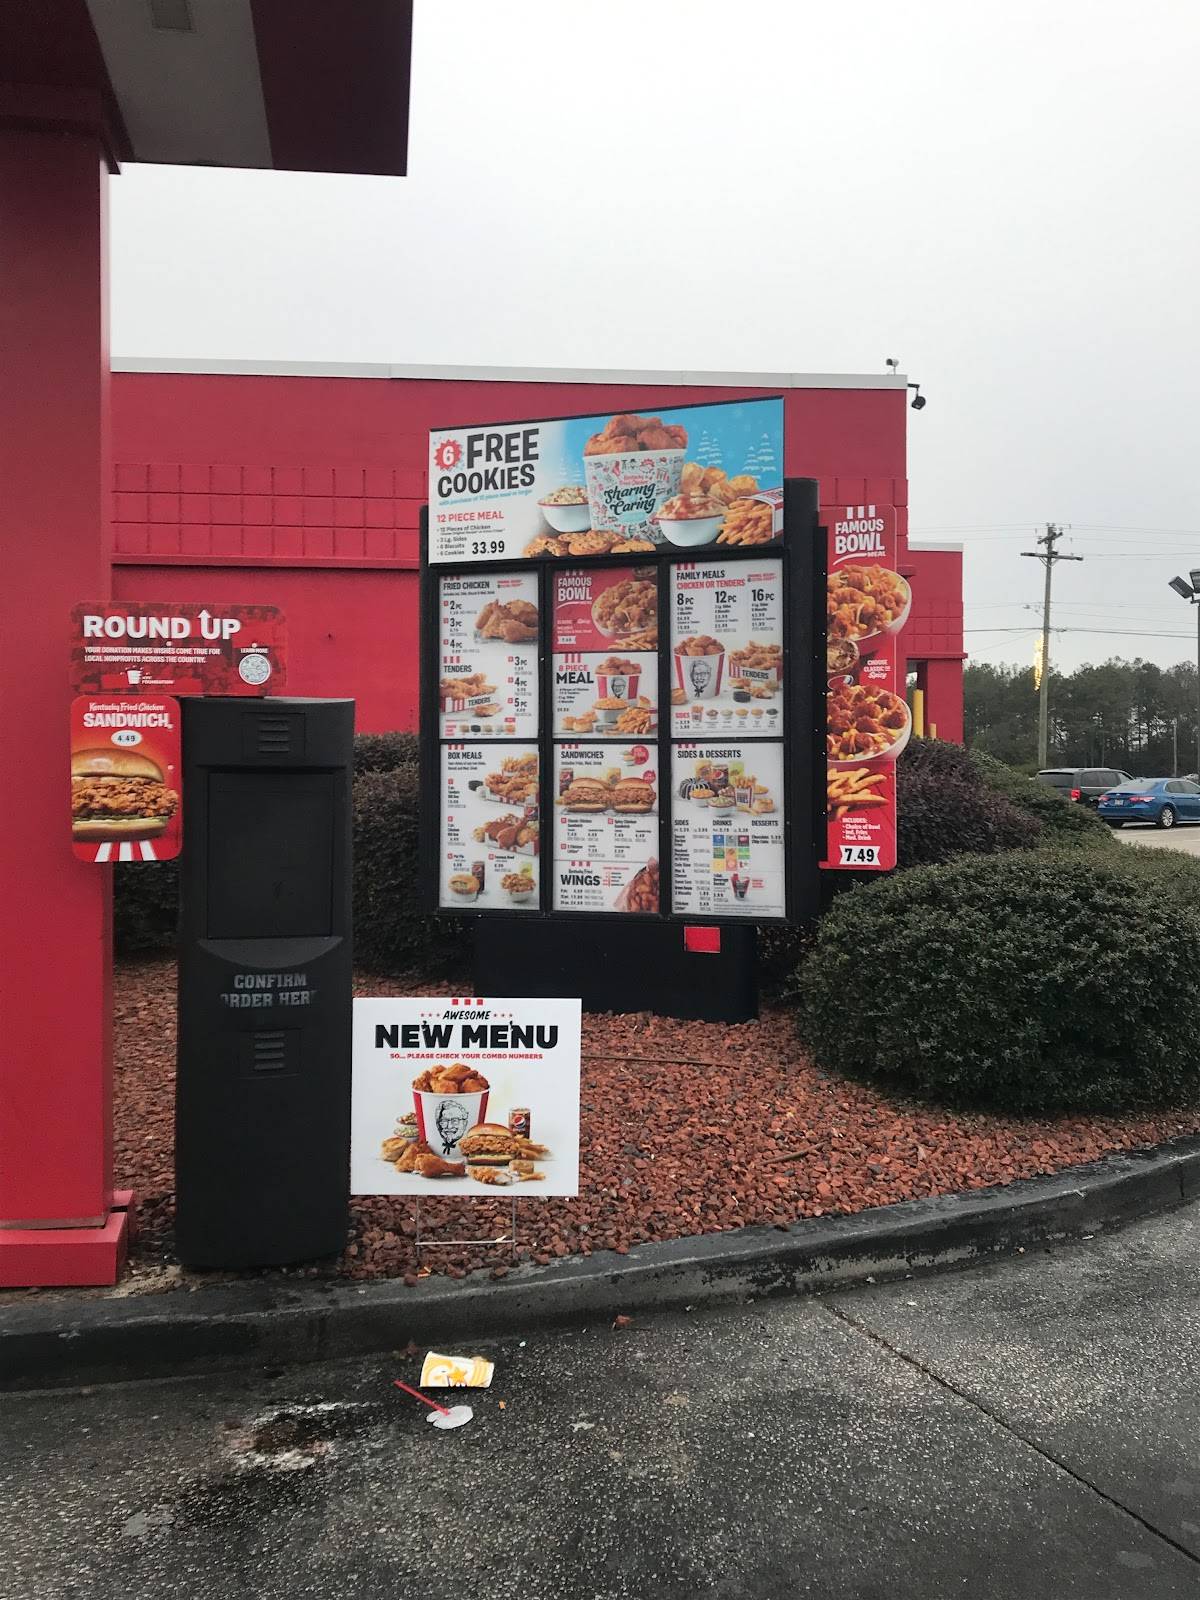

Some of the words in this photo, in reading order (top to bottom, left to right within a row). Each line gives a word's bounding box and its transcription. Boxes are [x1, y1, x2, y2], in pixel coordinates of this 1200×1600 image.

[442, 446, 455, 466] 6
[467, 428, 539, 469] FREE
[438, 463, 535, 498] COOKIES
[604, 483, 656, 504] Sharing
[610, 497, 656, 515] Caring
[437, 514, 446, 523] 12
[448, 512, 475, 522] PIECE
[478, 510, 504, 520] MEAL
[835, 518, 884, 534] FAMOUS
[472, 540, 505, 554] 33.99
[835, 532, 885, 554] BOWL
[677, 572, 700, 581] FAMILY
[702, 570, 725, 580] MEALS
[444, 582, 462, 590] FRIED
[462, 581, 490, 589] CHICKEN
[558, 577, 592, 587] FAMOUS
[677, 581, 704, 590] CHICKEN
[706, 580, 715, 588] OR
[716, 579, 746, 588] TENDERS
[558, 586, 592, 602] BOWL
[677, 593, 684, 606] 8
[715, 590, 727, 603] 12
[752, 588, 764, 602] 16
[450, 600, 455, 610] 2
[83, 615, 190, 639] ROUND
[198, 610, 241, 640] UP
[450, 618, 455, 627] 3
[450, 640, 455, 648] 4
[514, 656, 520, 666] 3
[444, 664, 472, 673] TENDERS
[742, 669, 769, 680] TENDERS
[514, 678, 520, 686] 4
[556, 672, 594, 684] MEAL
[89, 702, 120, 712] Kentucky
[120, 702, 138, 711] Fried
[138, 702, 166, 712] Chicken
[514, 698, 520, 707] 5
[84, 713, 169, 728] SANDWICH
[462, 752, 482, 760] MEALS
[560, 751, 604, 759] SANDWICHES
[678, 750, 698, 758] SIDES
[706, 750, 742, 758] DESSERTS
[844, 848, 875, 862] 7.49
[560, 874, 600, 886] WINGS
[234, 974, 306, 988] CONFIRM
[278, 990, 317, 1006] HER
[443, 1010, 491, 1020] AWESOME
[375, 1022, 454, 1048] NEW
[462, 1022, 558, 1048] MENU
